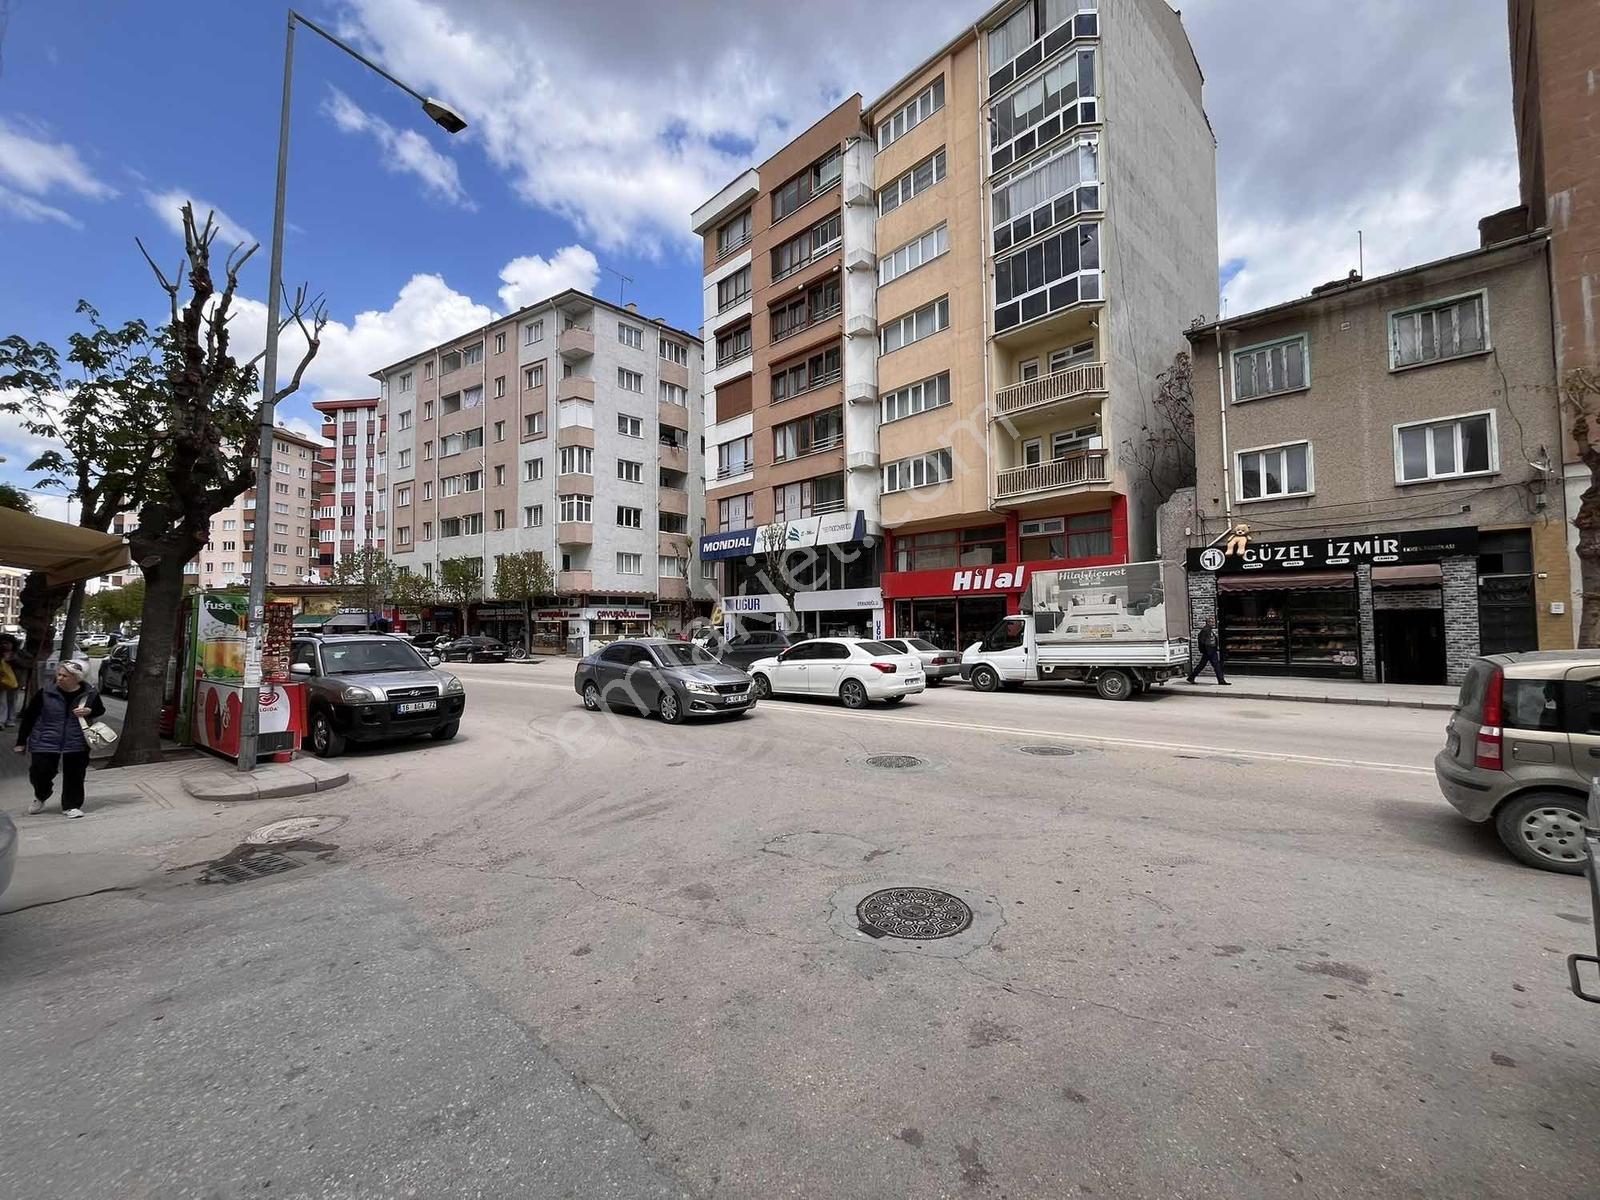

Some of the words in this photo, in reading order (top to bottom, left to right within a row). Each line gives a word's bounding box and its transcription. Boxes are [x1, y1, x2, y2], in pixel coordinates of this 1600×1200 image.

[702, 537, 752, 553] MONDIAL
[1243, 544, 1314, 562] GÜZEL
[1327, 536, 1399, 557] İZMİR
[952, 565, 1025, 591] Hilal
